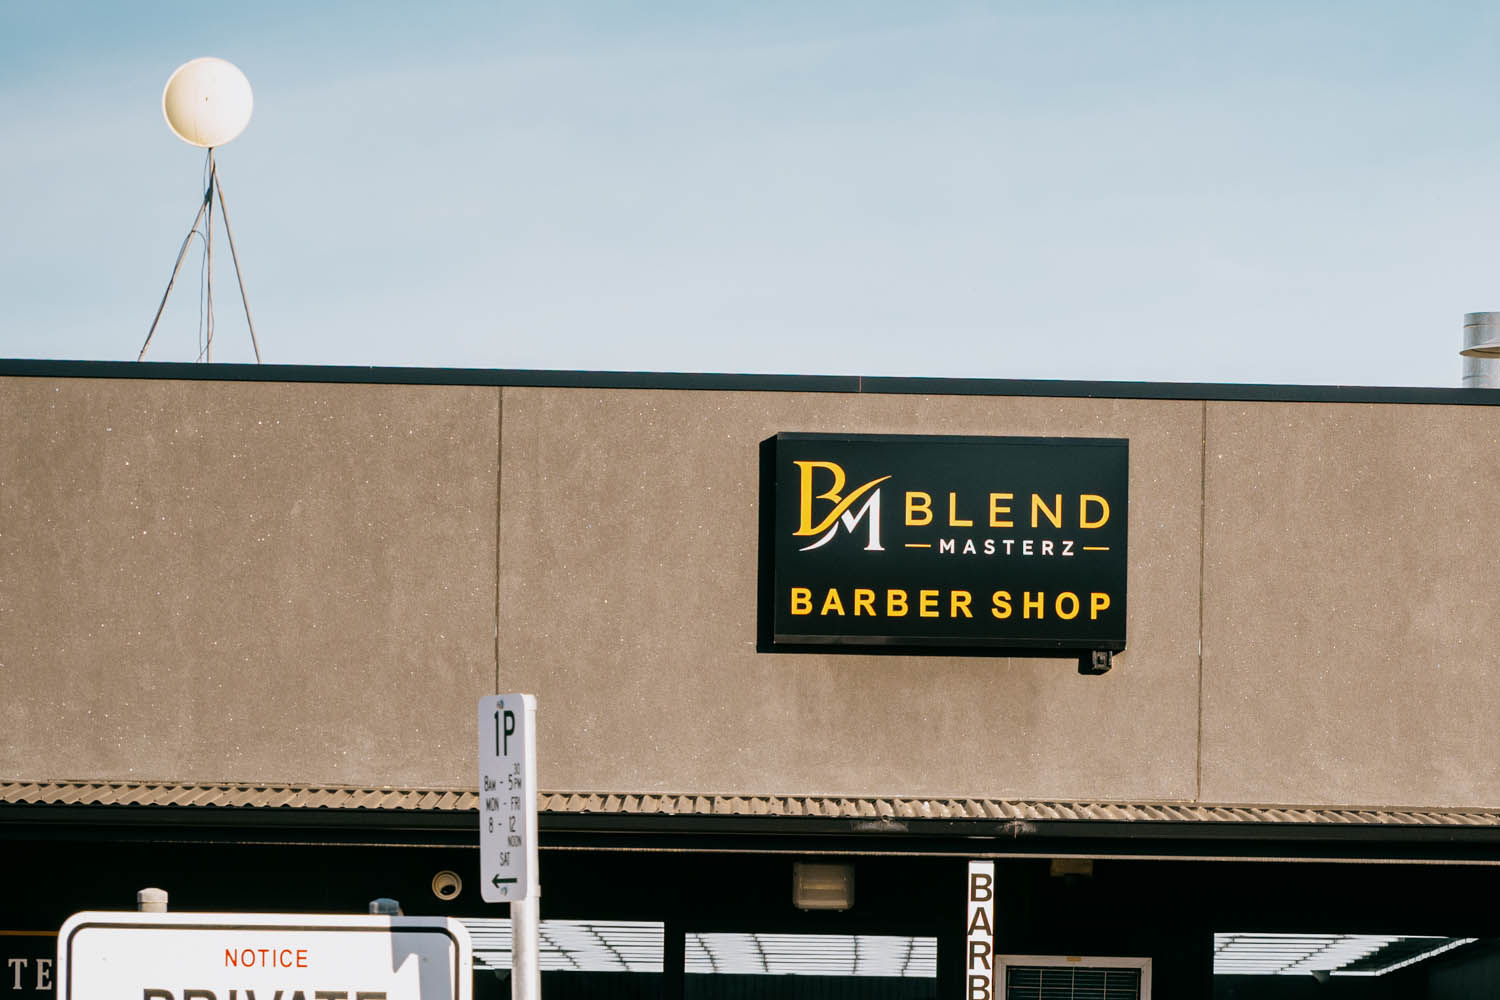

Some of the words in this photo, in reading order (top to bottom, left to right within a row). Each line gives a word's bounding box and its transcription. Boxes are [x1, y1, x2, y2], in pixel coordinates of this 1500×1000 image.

[906, 492, 1109, 528] BLEND
[940, 539, 1073, 555] MASTERZ
[791, 588, 973, 617] BARBER
[992, 591, 1110, 619] SHOP
[494, 710, 515, 756] 1P
[500, 851, 510, 866] SAT
[226, 949, 307, 967] NOTICE
